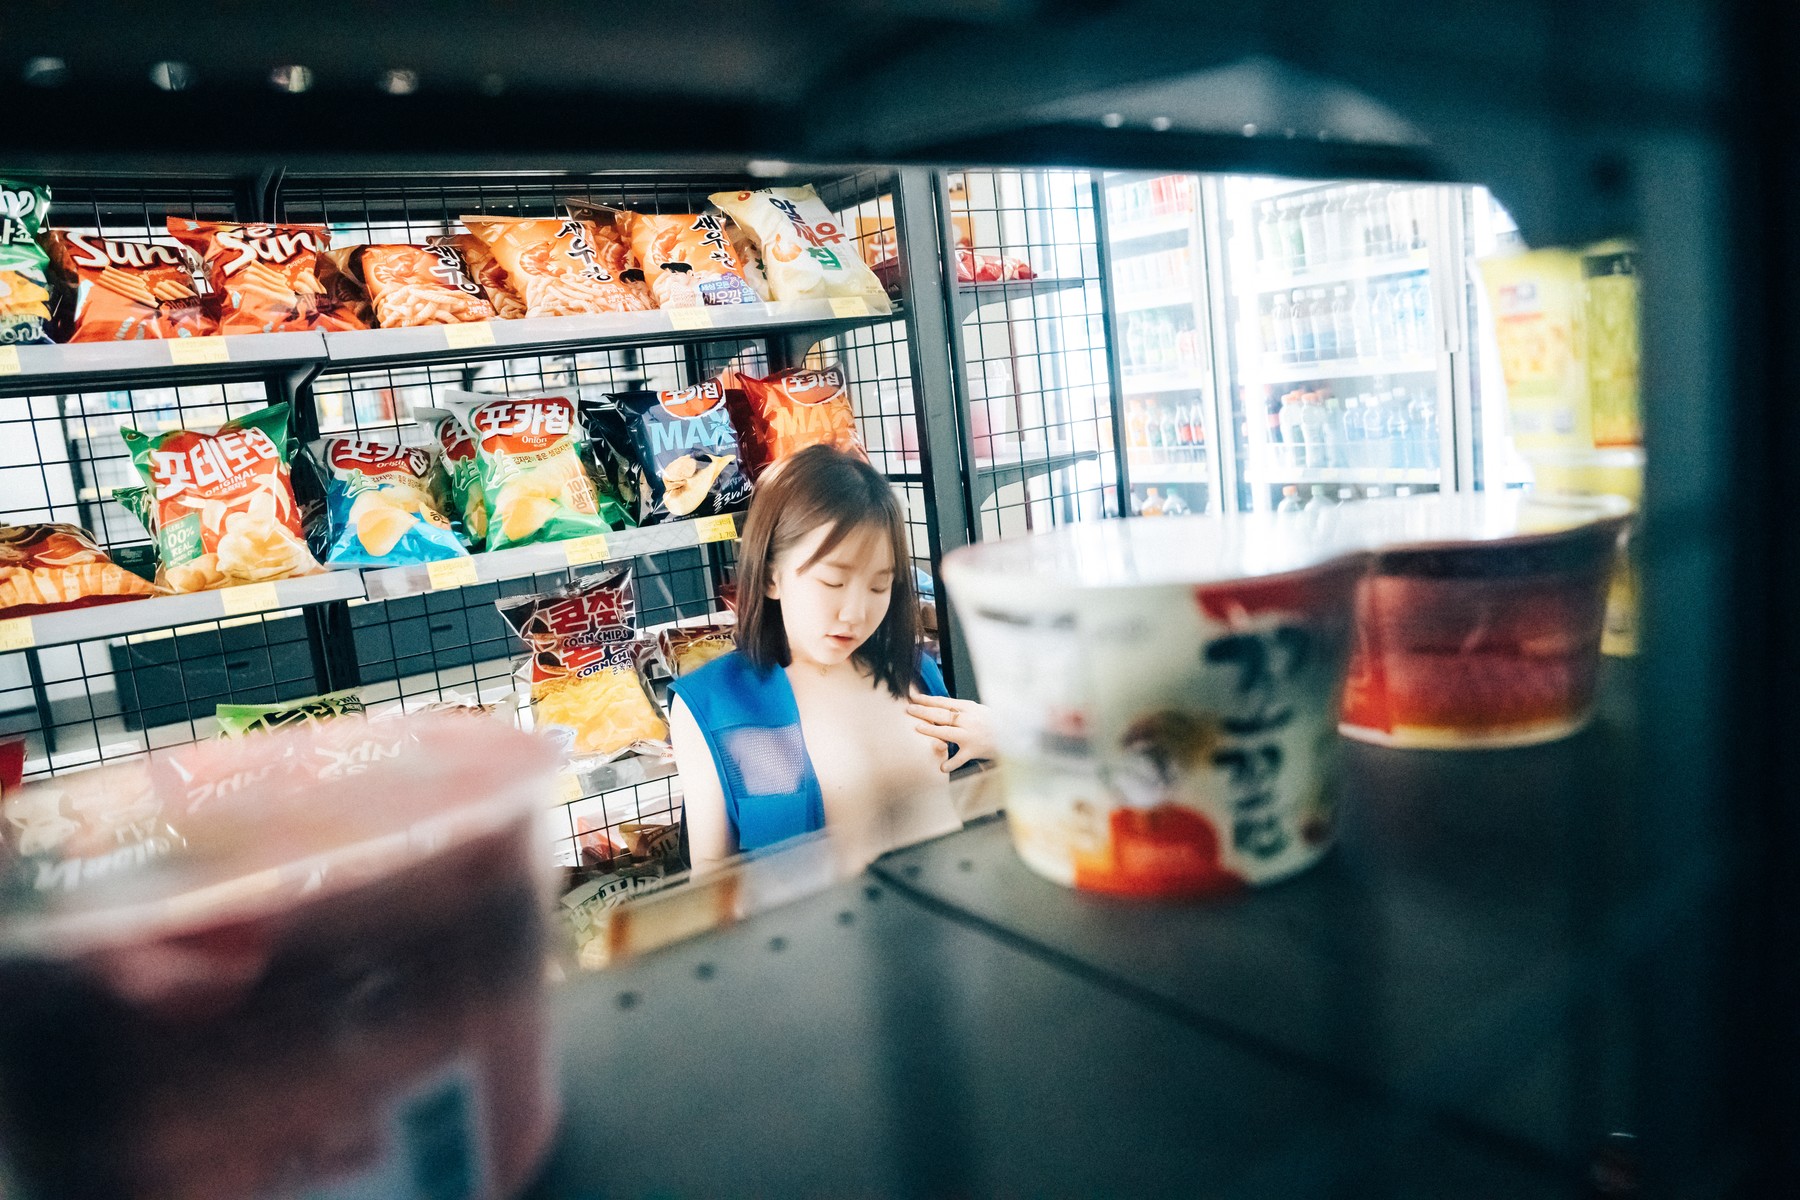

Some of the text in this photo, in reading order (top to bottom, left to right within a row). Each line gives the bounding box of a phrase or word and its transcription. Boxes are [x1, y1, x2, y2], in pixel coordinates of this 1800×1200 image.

[67, 232, 179, 268] Sun
[215, 229, 316, 277] Sun
[481, 402, 570, 437] 포카칩
[647, 408, 737, 456] MAX
[521, 435, 548, 444] Onion
[204, 468, 257, 496] ORIGINAL
[562, 628, 629, 649] CORN CHIPS
[576, 659, 610, 680] CORN
